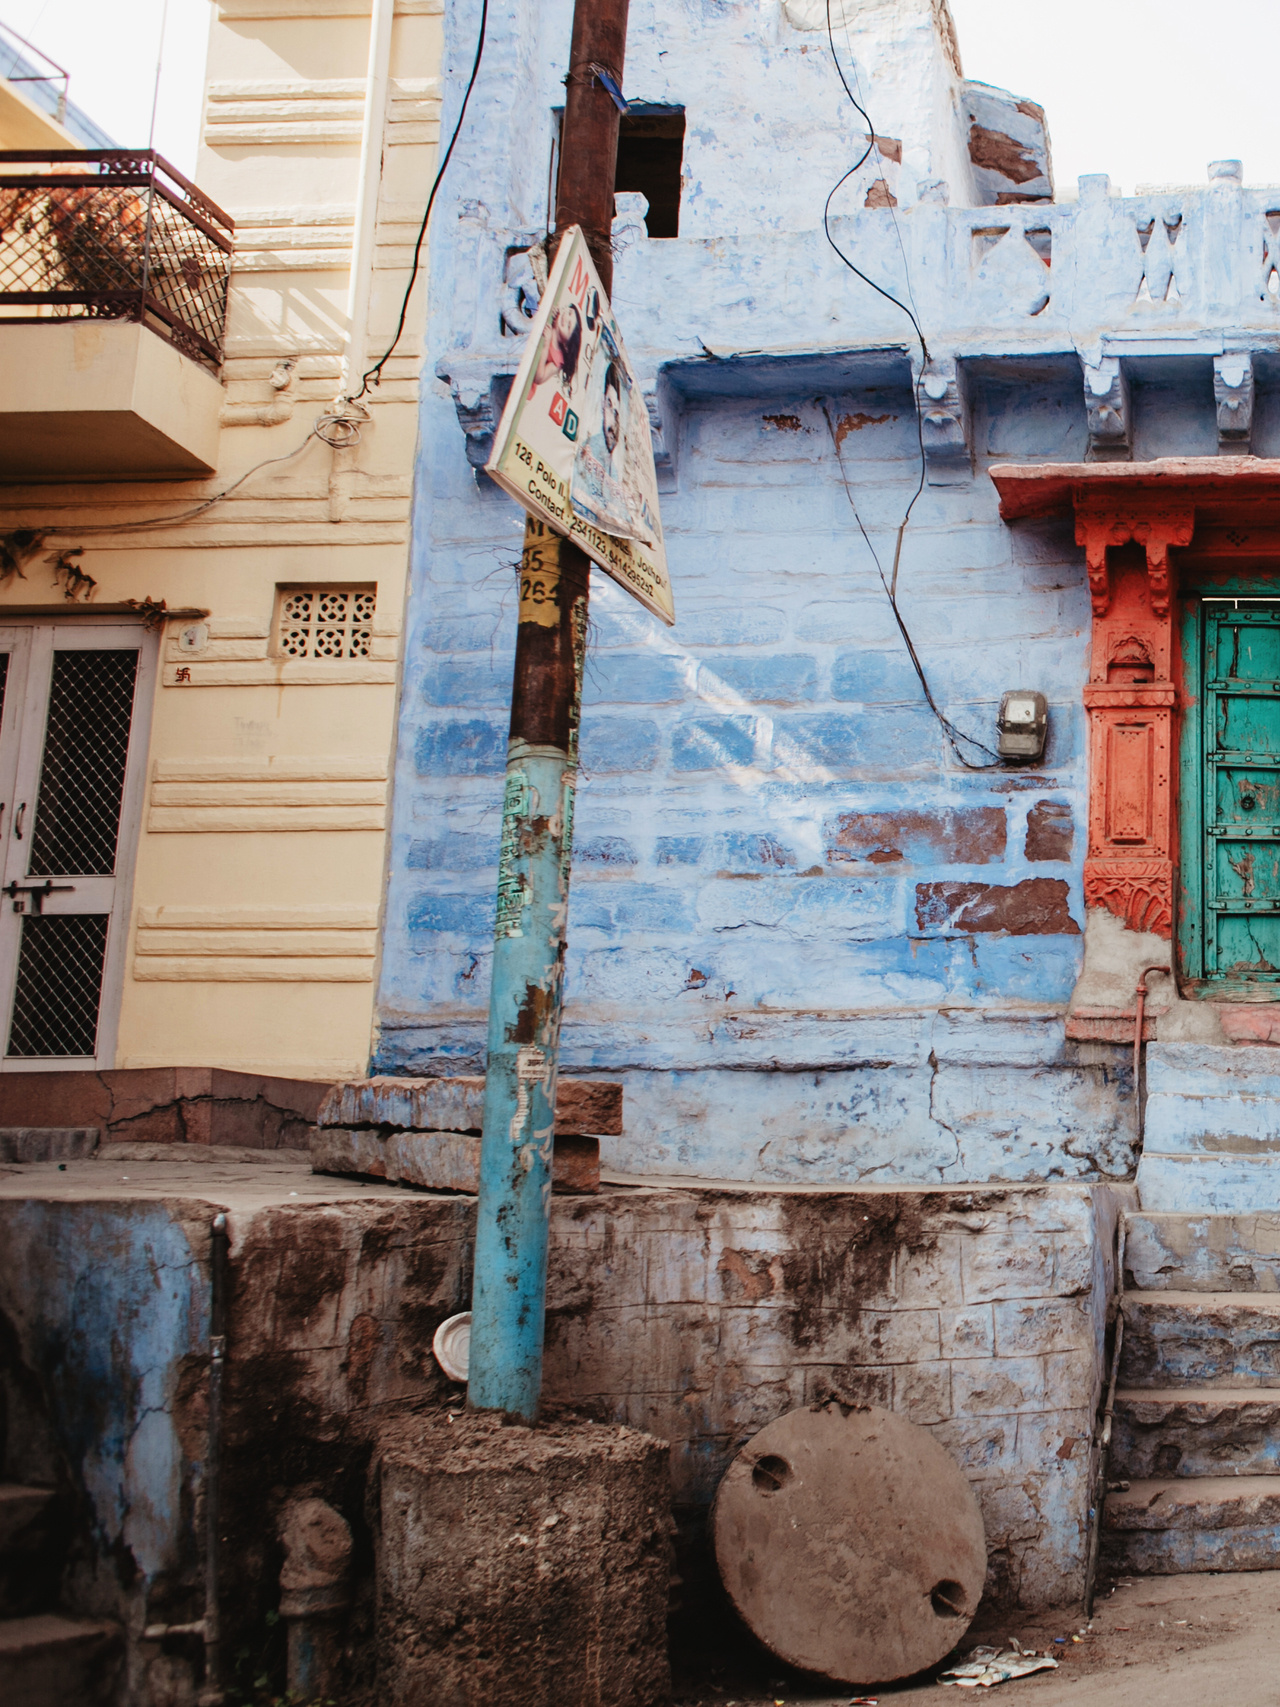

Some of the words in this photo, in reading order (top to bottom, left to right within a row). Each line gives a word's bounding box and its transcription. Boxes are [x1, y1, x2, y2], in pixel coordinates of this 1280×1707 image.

[515, 442, 533, 471] 128,
[536, 461, 557, 490] Polo
[528, 479, 565, 521] Contact
